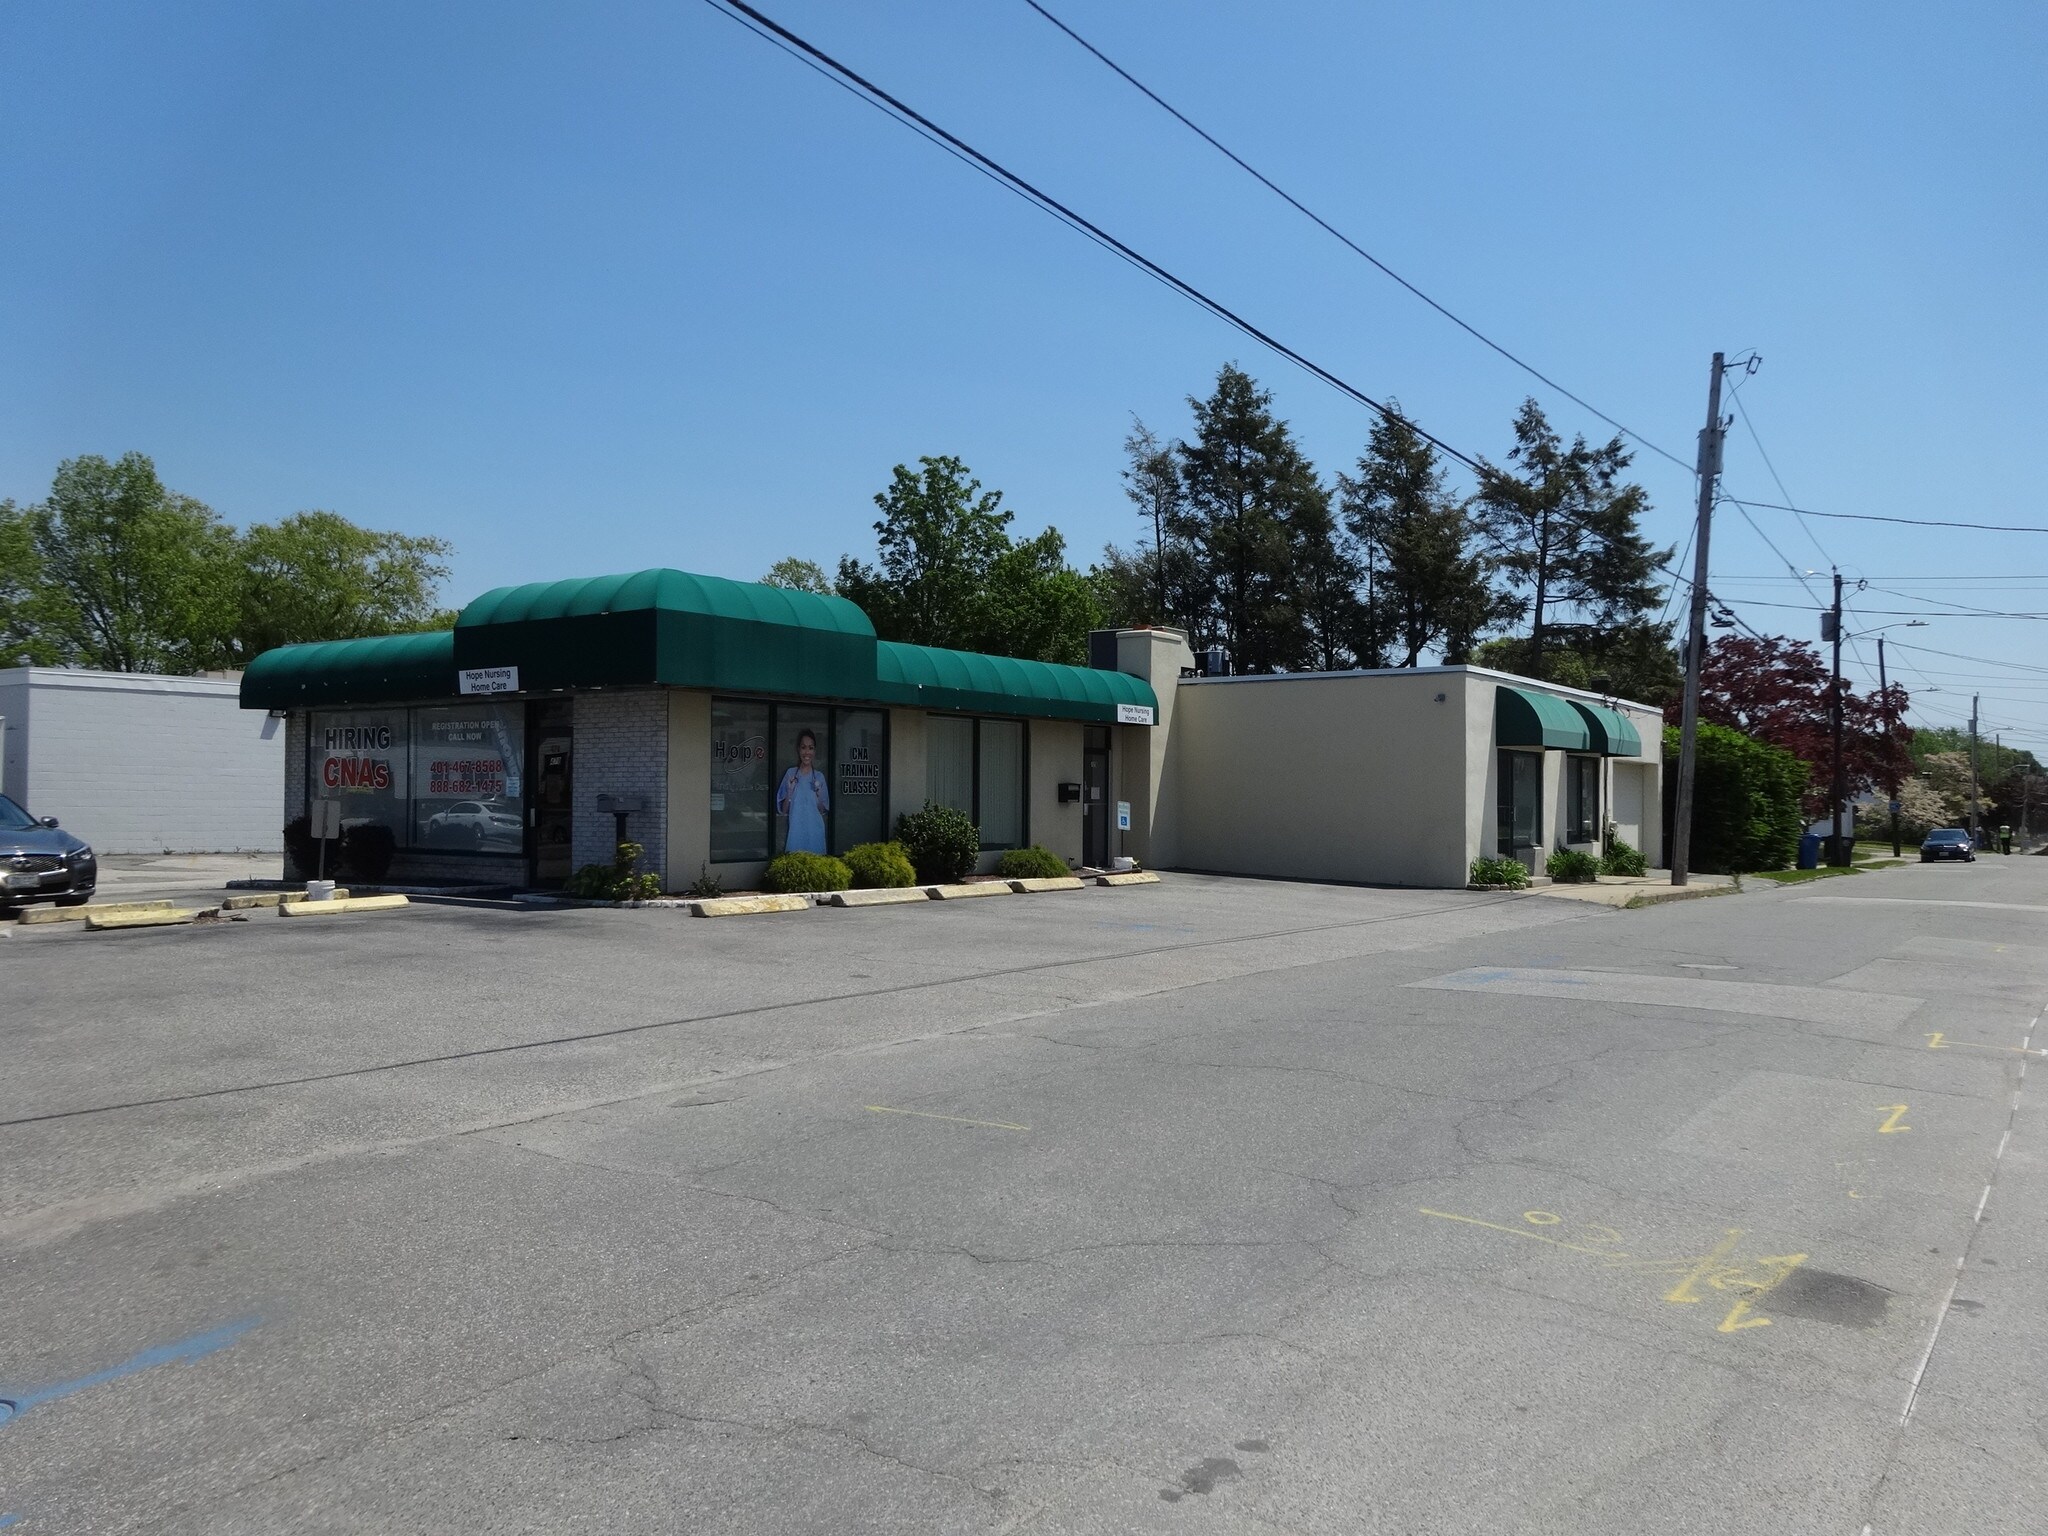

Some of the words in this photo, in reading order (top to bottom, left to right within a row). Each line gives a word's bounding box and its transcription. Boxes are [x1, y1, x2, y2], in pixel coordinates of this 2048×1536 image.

[466, 671, 483, 681] Hope
[484, 669, 511, 679] Nursing
[471, 683, 490, 692] Home
[491, 681, 507, 691] Care
[1122, 705, 1133, 714] Hope
[1134, 706, 1149, 717] Nursing
[432, 721, 479, 731] REGISTRATION
[480, 720, 500, 729] OPEN
[1125, 715, 1137, 723] Home
[1138, 716, 1147, 724] Care
[324, 725, 391, 752] HIRING
[448, 733, 465, 742] CALL
[466, 732, 482, 741] NOW
[714, 740, 765, 762] Hope
[851, 747, 869, 762] CNA
[323, 756, 390, 789] CNAs
[430, 759, 502, 774] 401-467-8588
[840, 763, 879, 778] TRAINING
[430, 779, 502, 794] 888-682-1475
[842, 781, 878, 795] CLASSES
